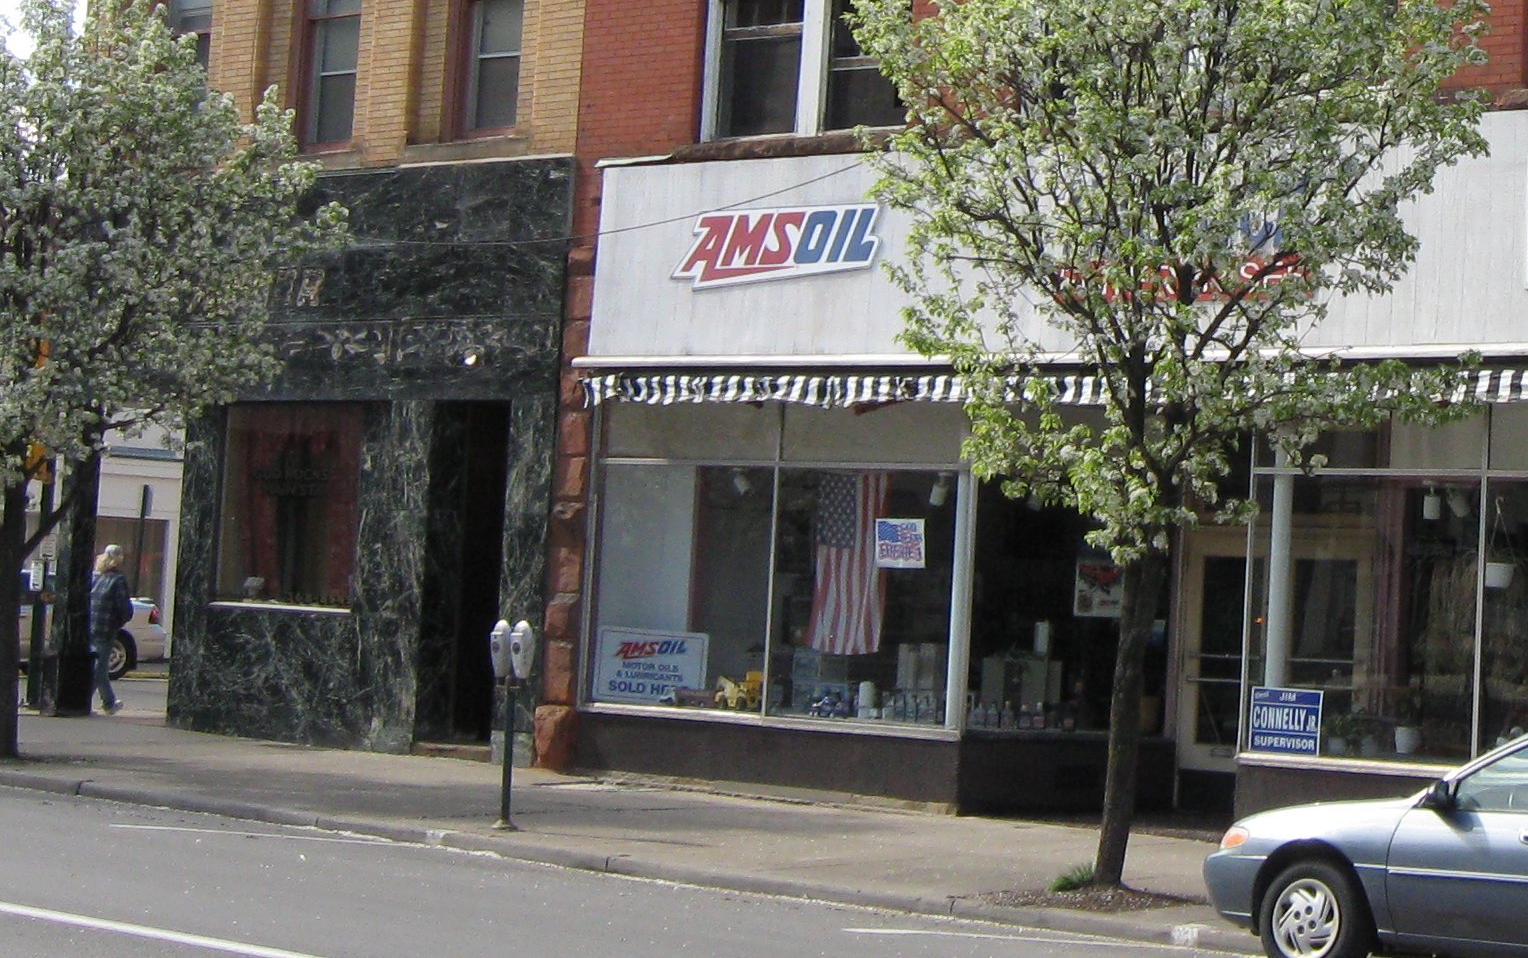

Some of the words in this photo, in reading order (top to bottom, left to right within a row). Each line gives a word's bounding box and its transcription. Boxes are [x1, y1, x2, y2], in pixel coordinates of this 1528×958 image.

[681, 208, 876, 282] AMSOIL
[613, 640, 687, 659] AMSOIL
[622, 660, 655, 671] MOTOR
[658, 664, 681, 673] OILS
[625, 669, 684, 682] LUBRICANTS
[609, 680, 646, 694] SOLD
[1279, 692, 1297, 702] JIM
[1253, 706, 1308, 732] CONNELLY
[1254, 735, 1315, 751] SUPERVISOR
